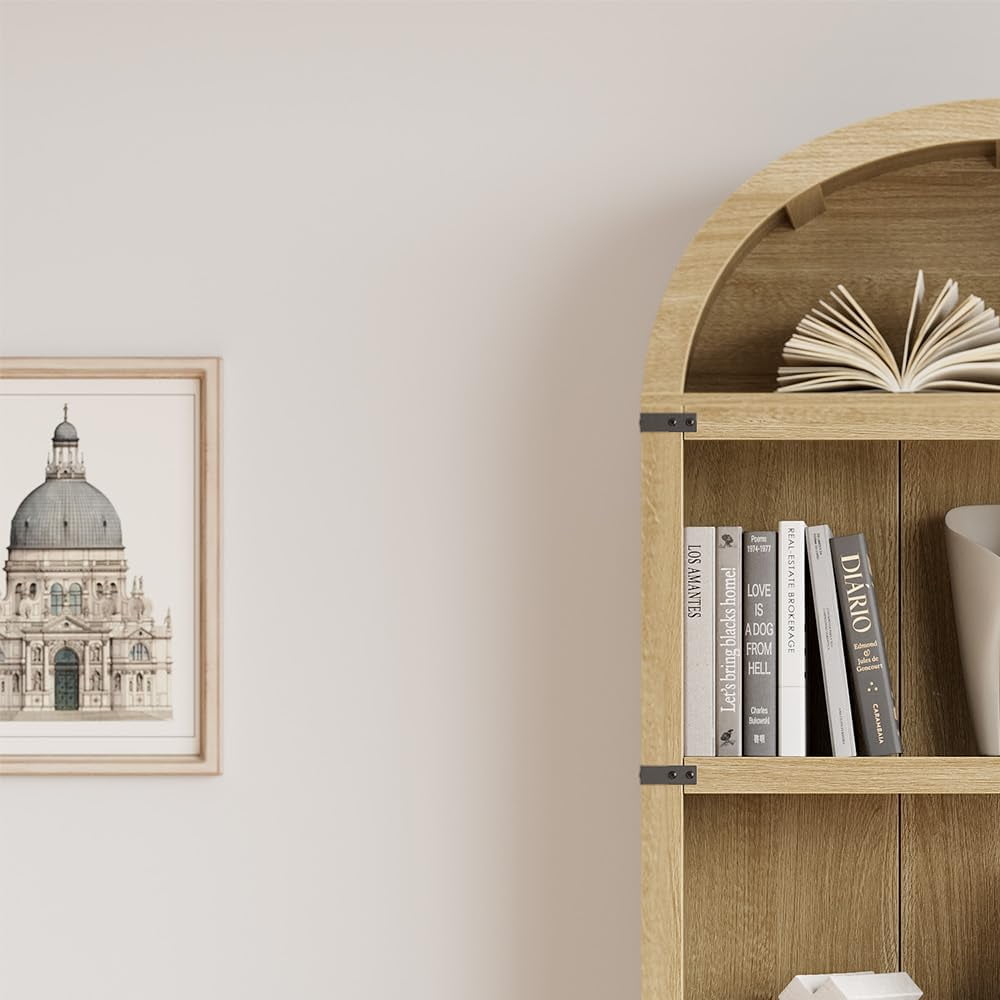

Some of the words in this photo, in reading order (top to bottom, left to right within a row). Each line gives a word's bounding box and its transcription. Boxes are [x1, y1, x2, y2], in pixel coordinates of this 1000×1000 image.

[687, 544, 702, 564] LOS
[687, 567, 702, 619] AMANTES
[720, 567, 736, 606] home!
[747, 583, 772, 597] LOVE
[840, 553, 872, 633] DIÁRIO
[754, 603, 764, 617] IS
[720, 608, 736, 647] blacks
[744, 622, 752, 636] A
[752, 622, 774, 636] DOG
[787, 592, 796, 654] BROKERAGE
[746, 642, 773, 656] FROM
[853, 640, 878, 650] Edmond
[720, 648, 740, 681] bring
[856, 663, 883, 673] Goncourt
